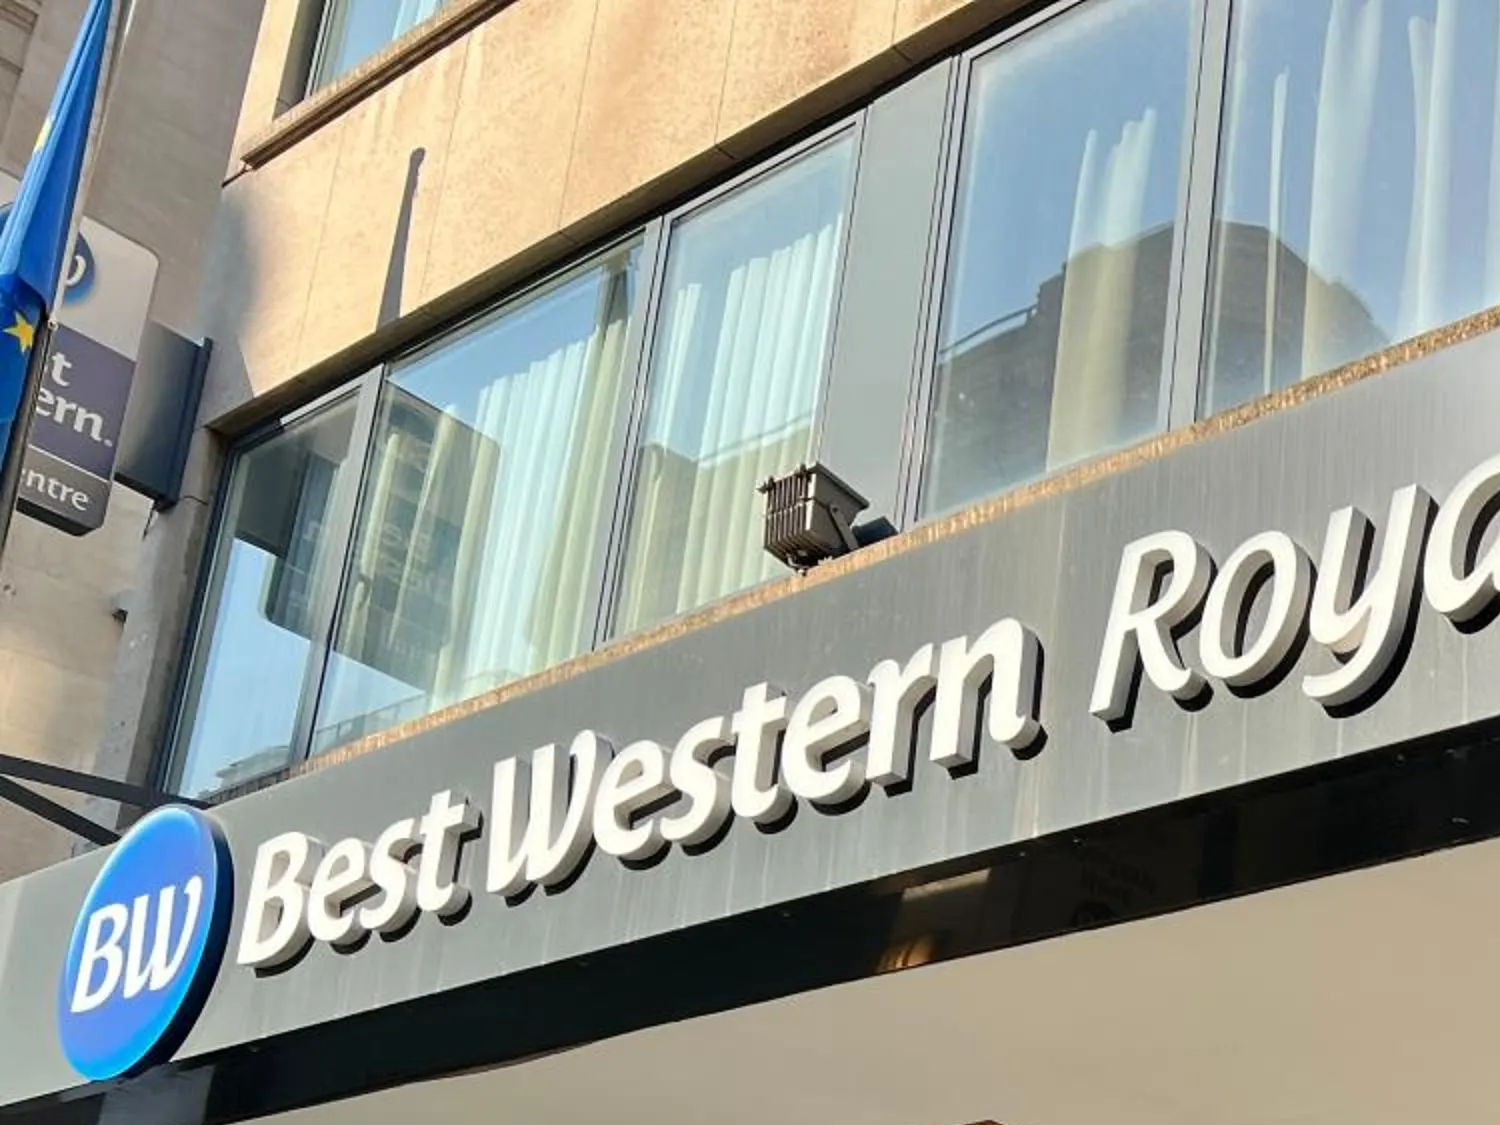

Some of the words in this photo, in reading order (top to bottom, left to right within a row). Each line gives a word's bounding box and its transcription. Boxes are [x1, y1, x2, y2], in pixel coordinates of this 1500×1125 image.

[69, 874, 204, 1014] BW
[237, 790, 480, 974] Best
[486, 617, 1046, 906] Western
